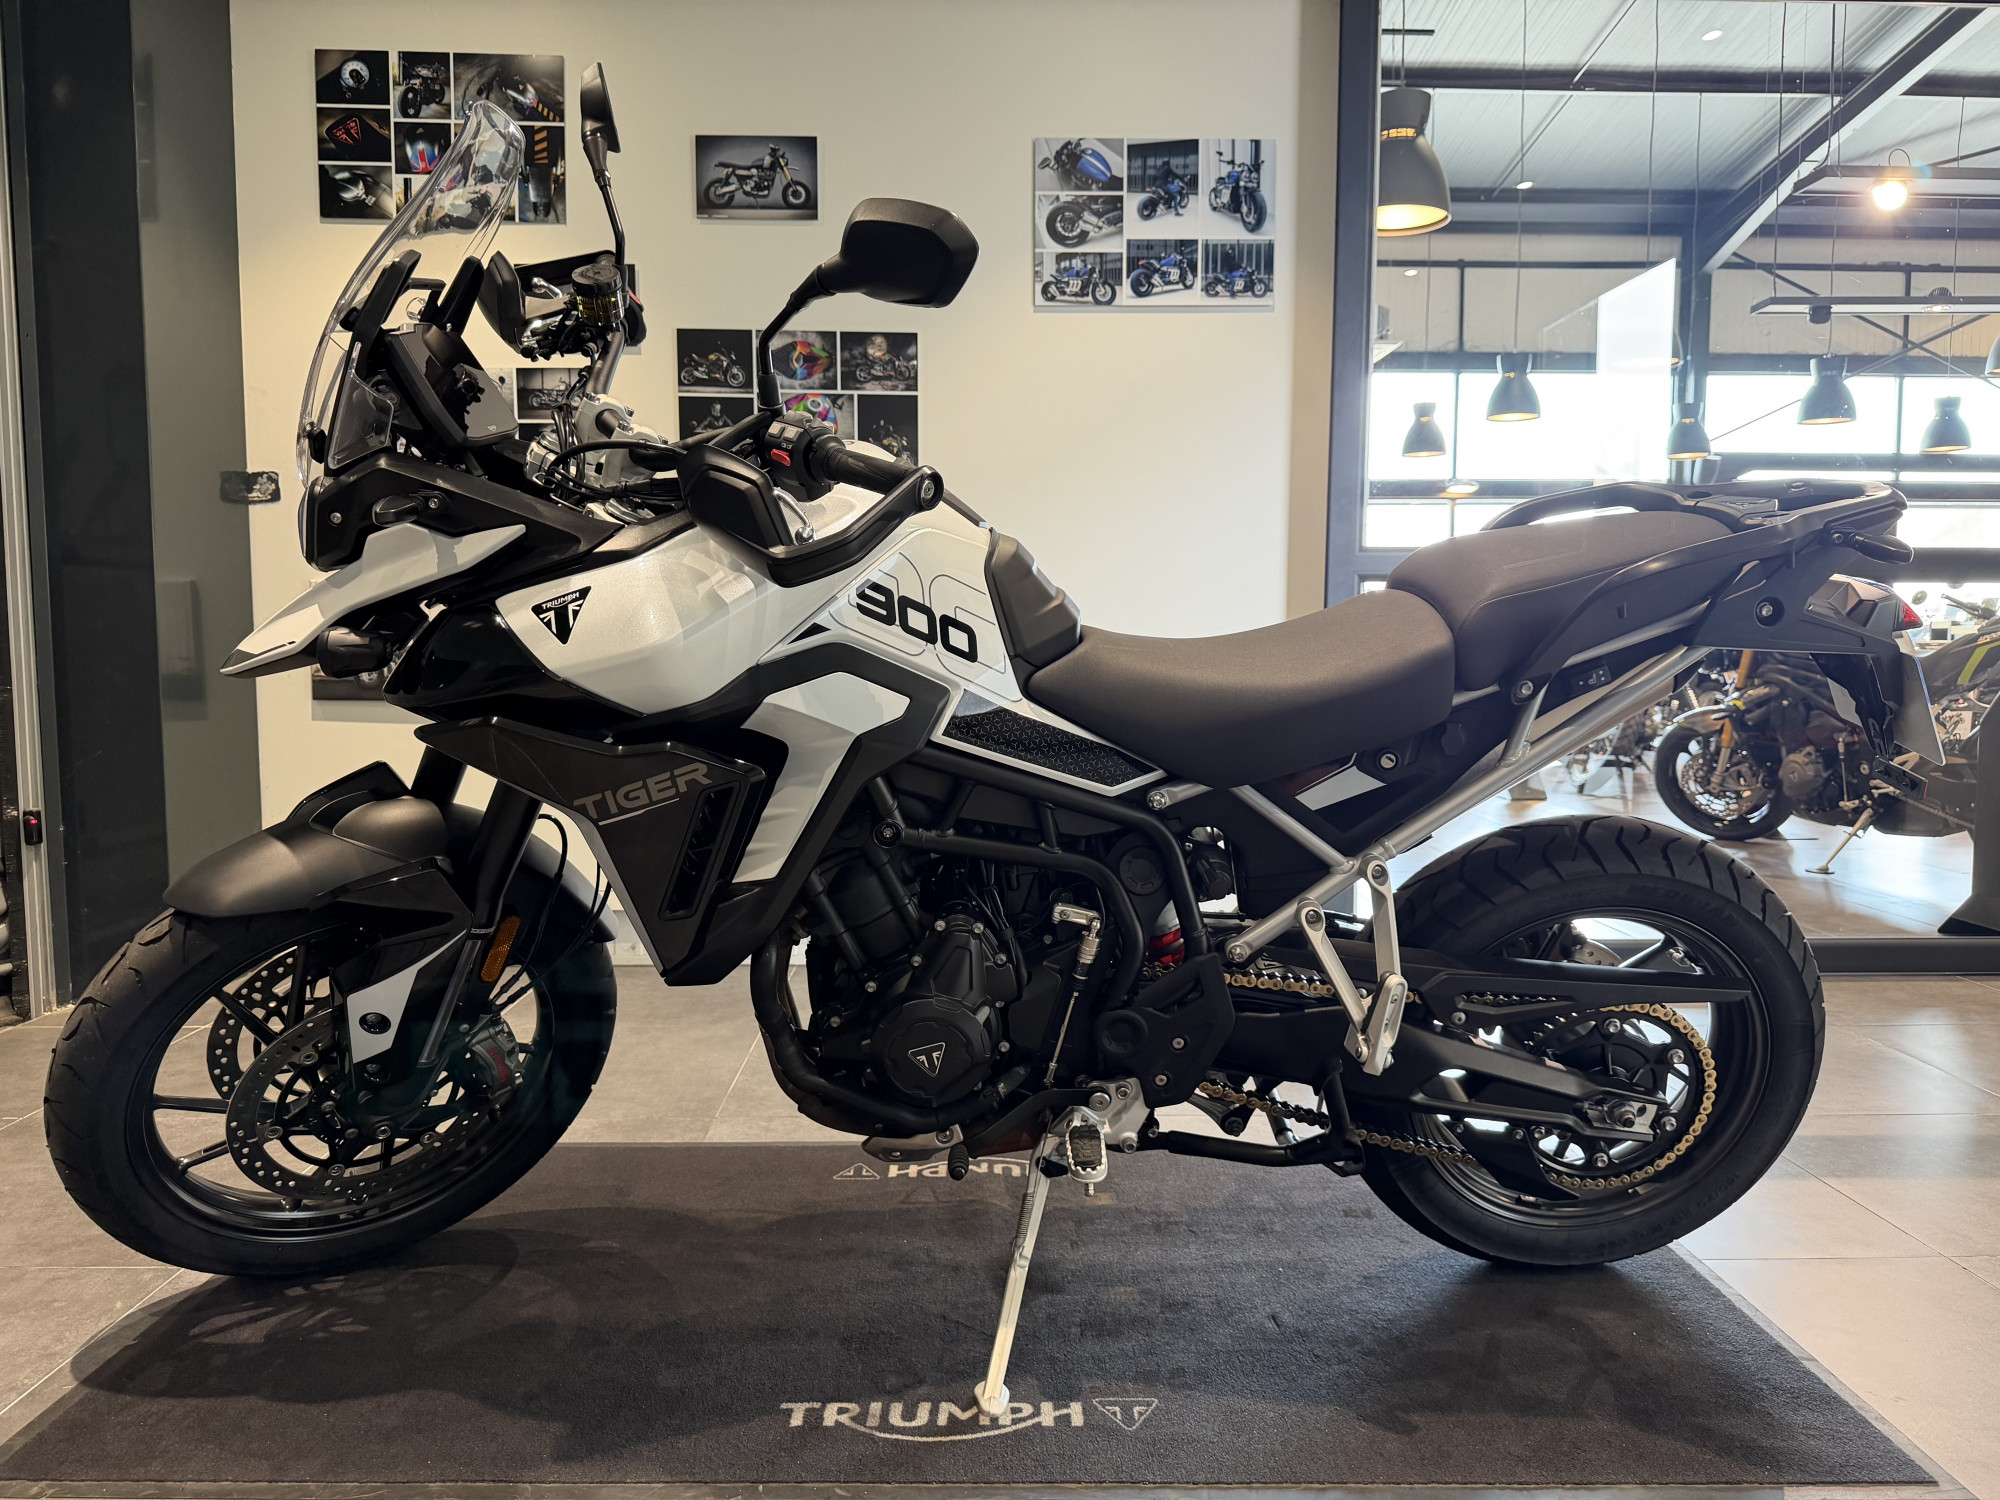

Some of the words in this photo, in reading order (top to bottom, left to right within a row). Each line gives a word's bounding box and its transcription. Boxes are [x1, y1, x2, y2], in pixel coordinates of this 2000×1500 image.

[541, 591, 580, 610] TRIUMPH
[856, 578, 978, 663] 900
[573, 762, 713, 819] TIGER
[780, 1401, 1084, 1430] TRIUMPH
